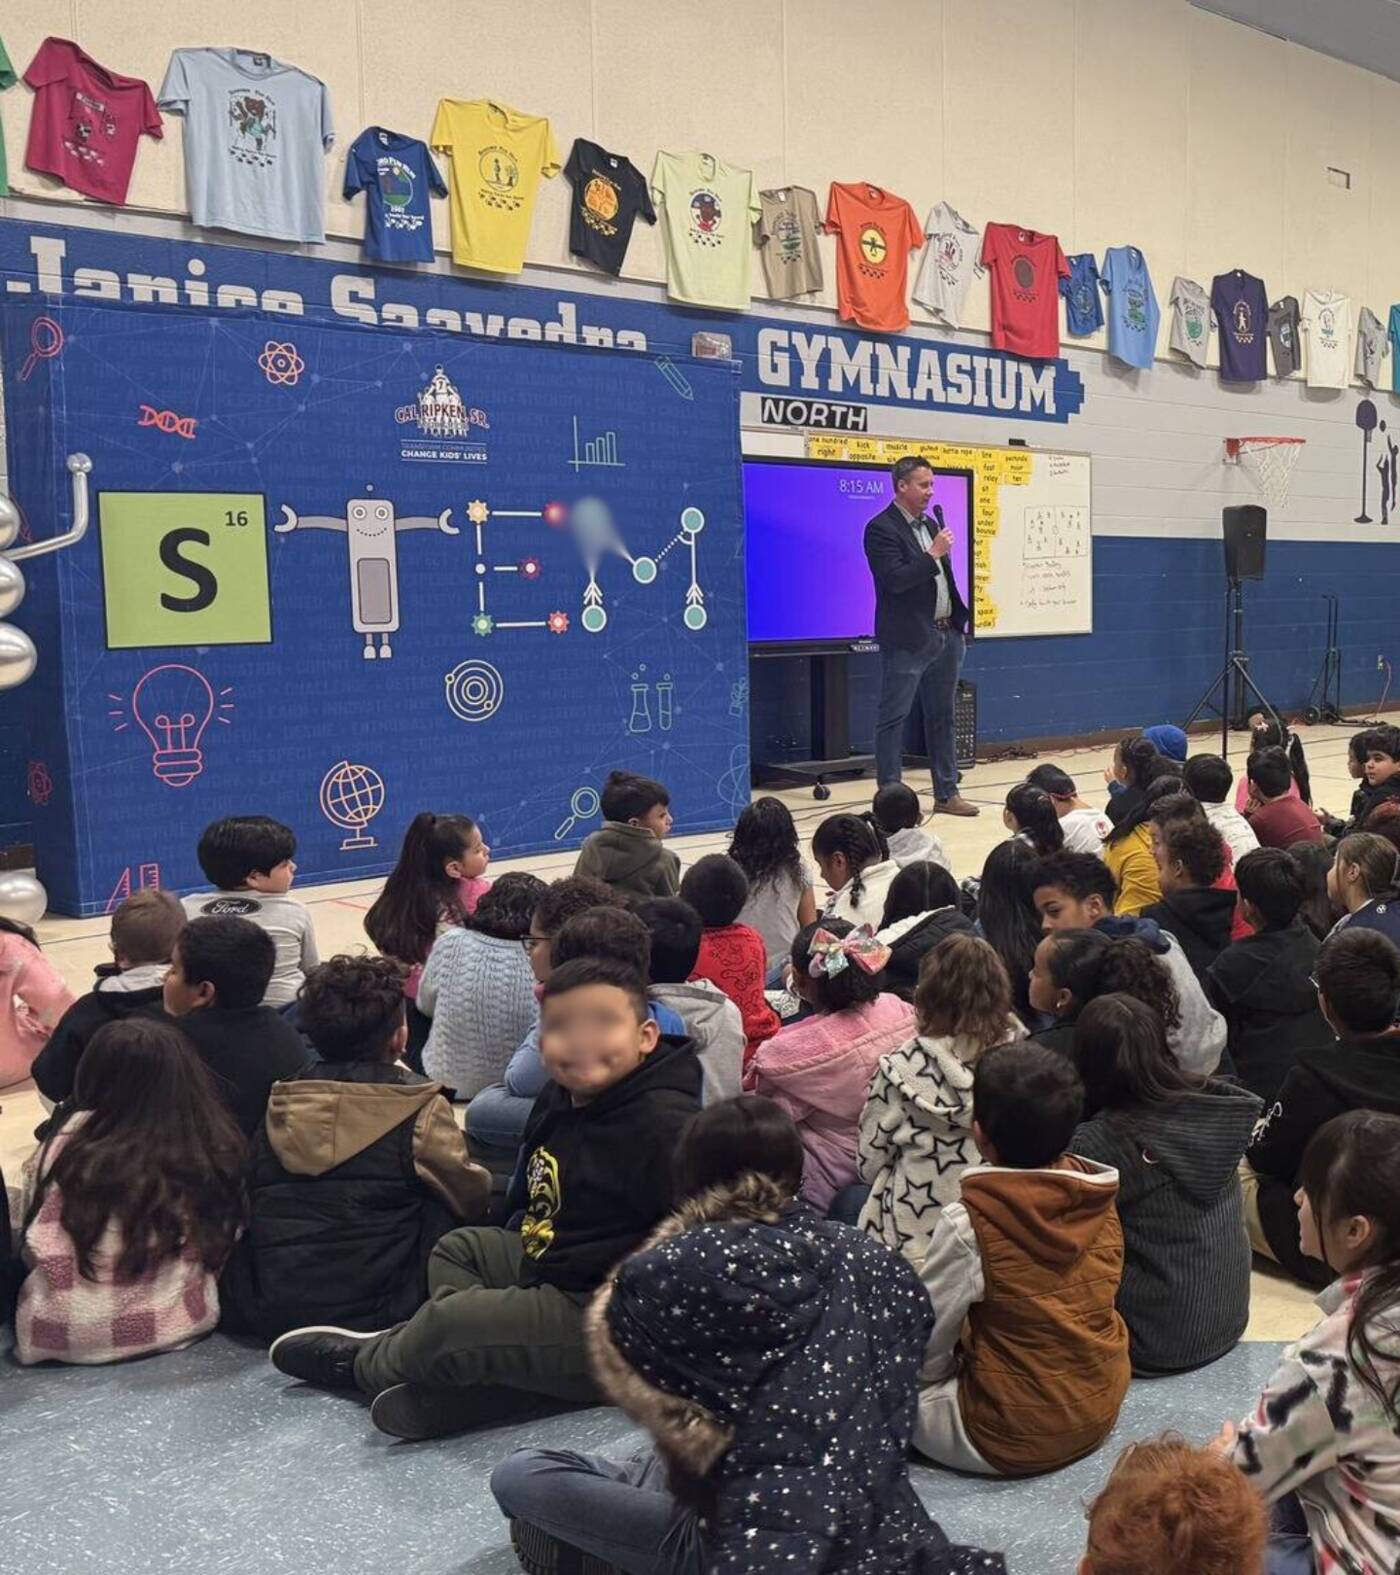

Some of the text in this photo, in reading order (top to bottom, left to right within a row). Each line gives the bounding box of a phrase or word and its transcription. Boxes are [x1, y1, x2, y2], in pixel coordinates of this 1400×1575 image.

[758, 328, 1056, 414] GYMNASIUM
[395, 404, 420, 424] CAL
[762, 400, 866, 430] NORTH
[401, 449, 488, 461] CHANGE KIDS' LIVES
[840, 480, 884, 494] 8:15 AM
[225, 511, 248, 526] 16
[159, 527, 218, 612] S
[211, 900, 250, 914] Ford
